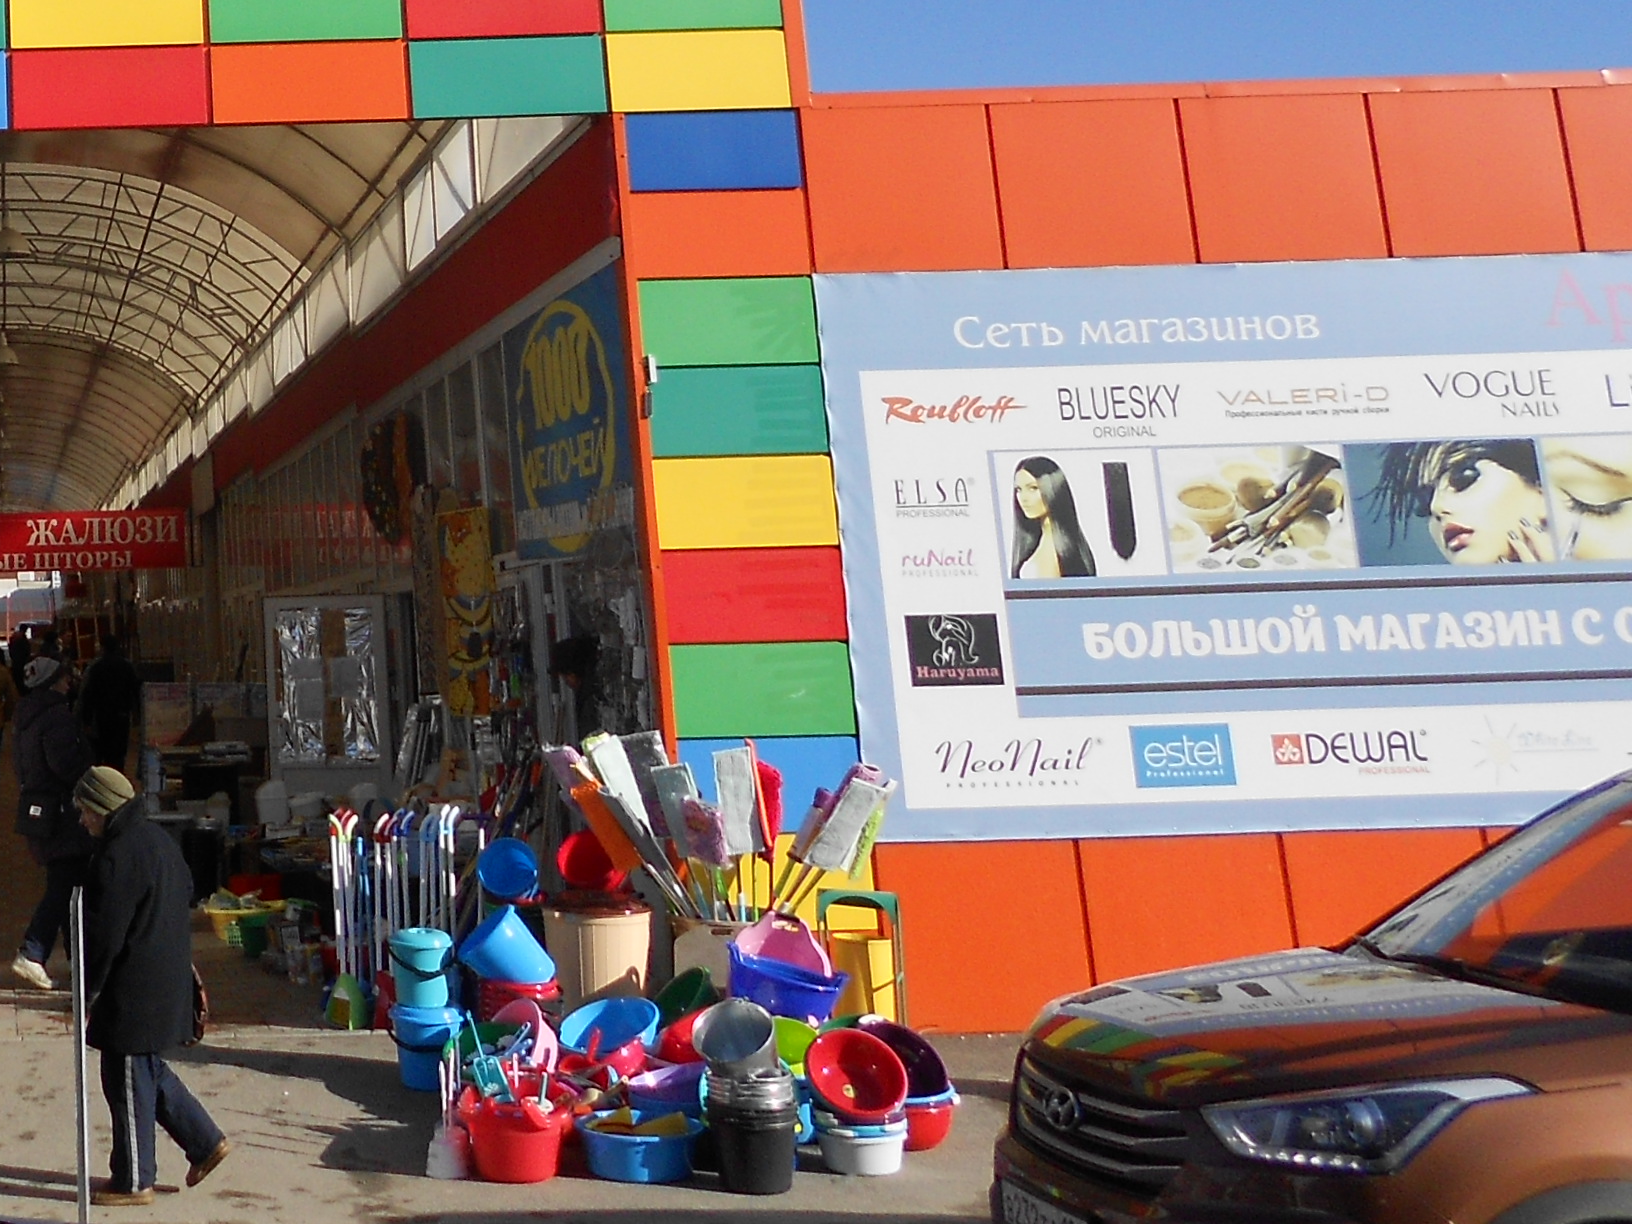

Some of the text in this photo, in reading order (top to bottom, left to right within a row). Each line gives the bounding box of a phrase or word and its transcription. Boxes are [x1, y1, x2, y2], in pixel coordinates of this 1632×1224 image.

[953, 312, 1320, 349] Сеть магазинов
[1424, 369, 1557, 398] VOGUE
[881, 394, 1027, 425] Roubloff
[1057, 384, 1180, 421] BLUESKY
[1093, 425, 1157, 439] ORIGINAL
[893, 478, 968, 505] ELSA
[896, 508, 970, 518] PROFESSIONAL
[27, 515, 179, 547] ЖАЛЮЗИ
[33, 550, 132, 571] ШТОРЫ
[901, 548, 973, 567] ruNail
[901, 569, 979, 578] PROFESSIONAL
[1082, 604, 1328, 659] БОЛЬШОЙ
[1334, 608, 1562, 652] МАГАЗИН
[916, 664, 999, 680] Haruyama
[1143, 734, 1222, 769] estel
[1307, 730, 1429, 764] DEWAL
[1145, 768, 1225, 779] Professional
[1358, 764, 1431, 775] PROFESSIONAL
